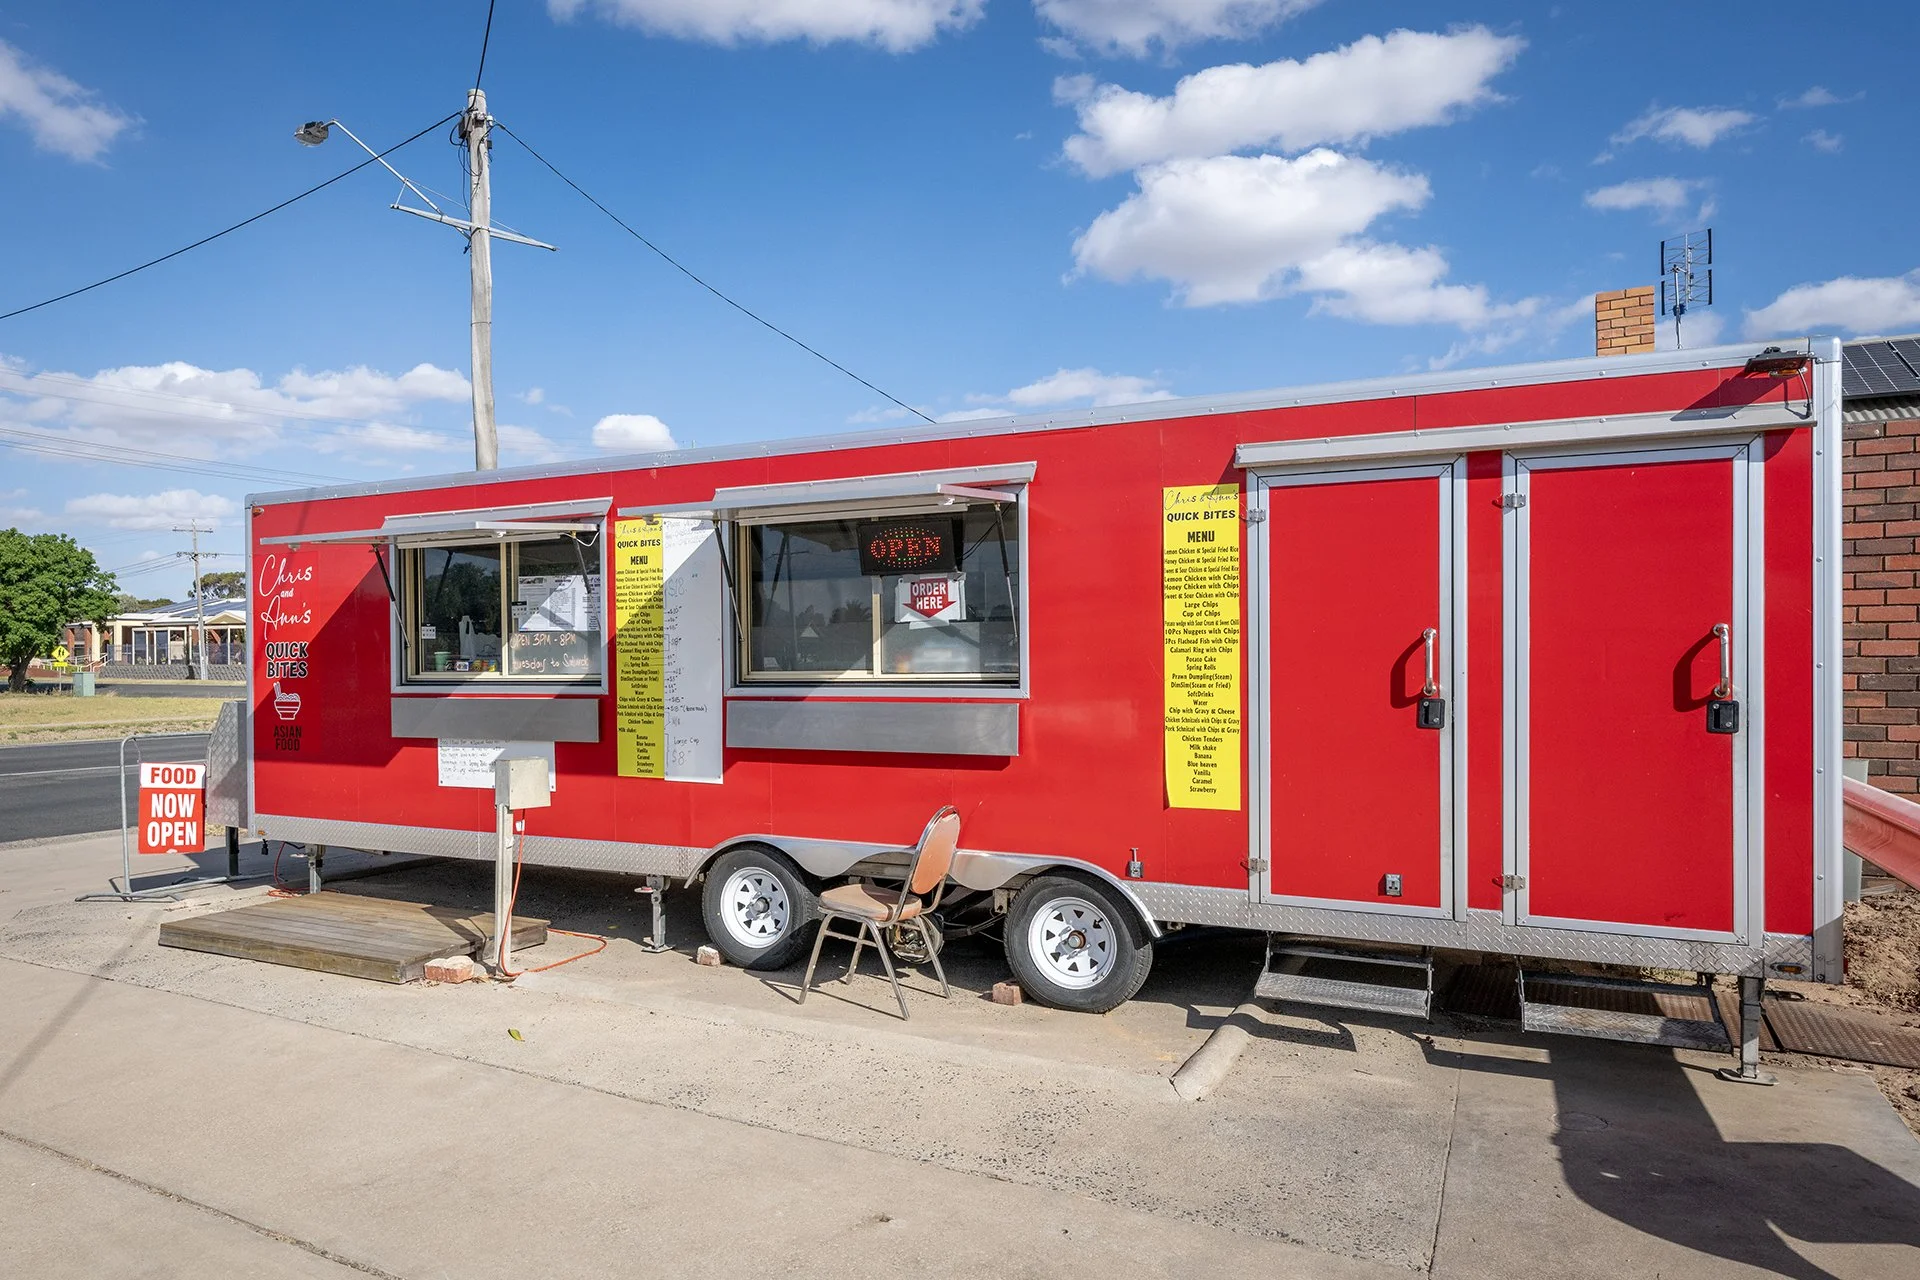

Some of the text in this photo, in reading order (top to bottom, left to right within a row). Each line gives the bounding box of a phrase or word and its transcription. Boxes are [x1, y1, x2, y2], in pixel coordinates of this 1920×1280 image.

[1164, 490, 1196, 510] Chris
[1167, 510, 1235, 522] QUICK BITES
[640, 539, 660, 547] BITES
[1188, 531, 1215, 542] MENU
[871, 536, 941, 558] OPEN
[630, 556, 648, 565] MENU
[259, 554, 312, 597] Chris
[280, 588, 294, 598] and
[912, 582, 947, 596] ORDER
[916, 596, 943, 609] HERE
[260, 595, 312, 640] Ann's
[533, 634, 551, 646] 3PM
[265, 642, 309, 662] QUICK
[266, 661, 308, 678] BITES
[551, 659, 559, 667] to
[274, 725, 302, 738] ASIAN
[275, 738, 300, 751] FOOD
[151, 768, 196, 784] FOOD
[1190, 786, 1216, 794] Strawberry
[151, 793, 195, 818] NOW
[147, 821, 197, 847] OPEN
